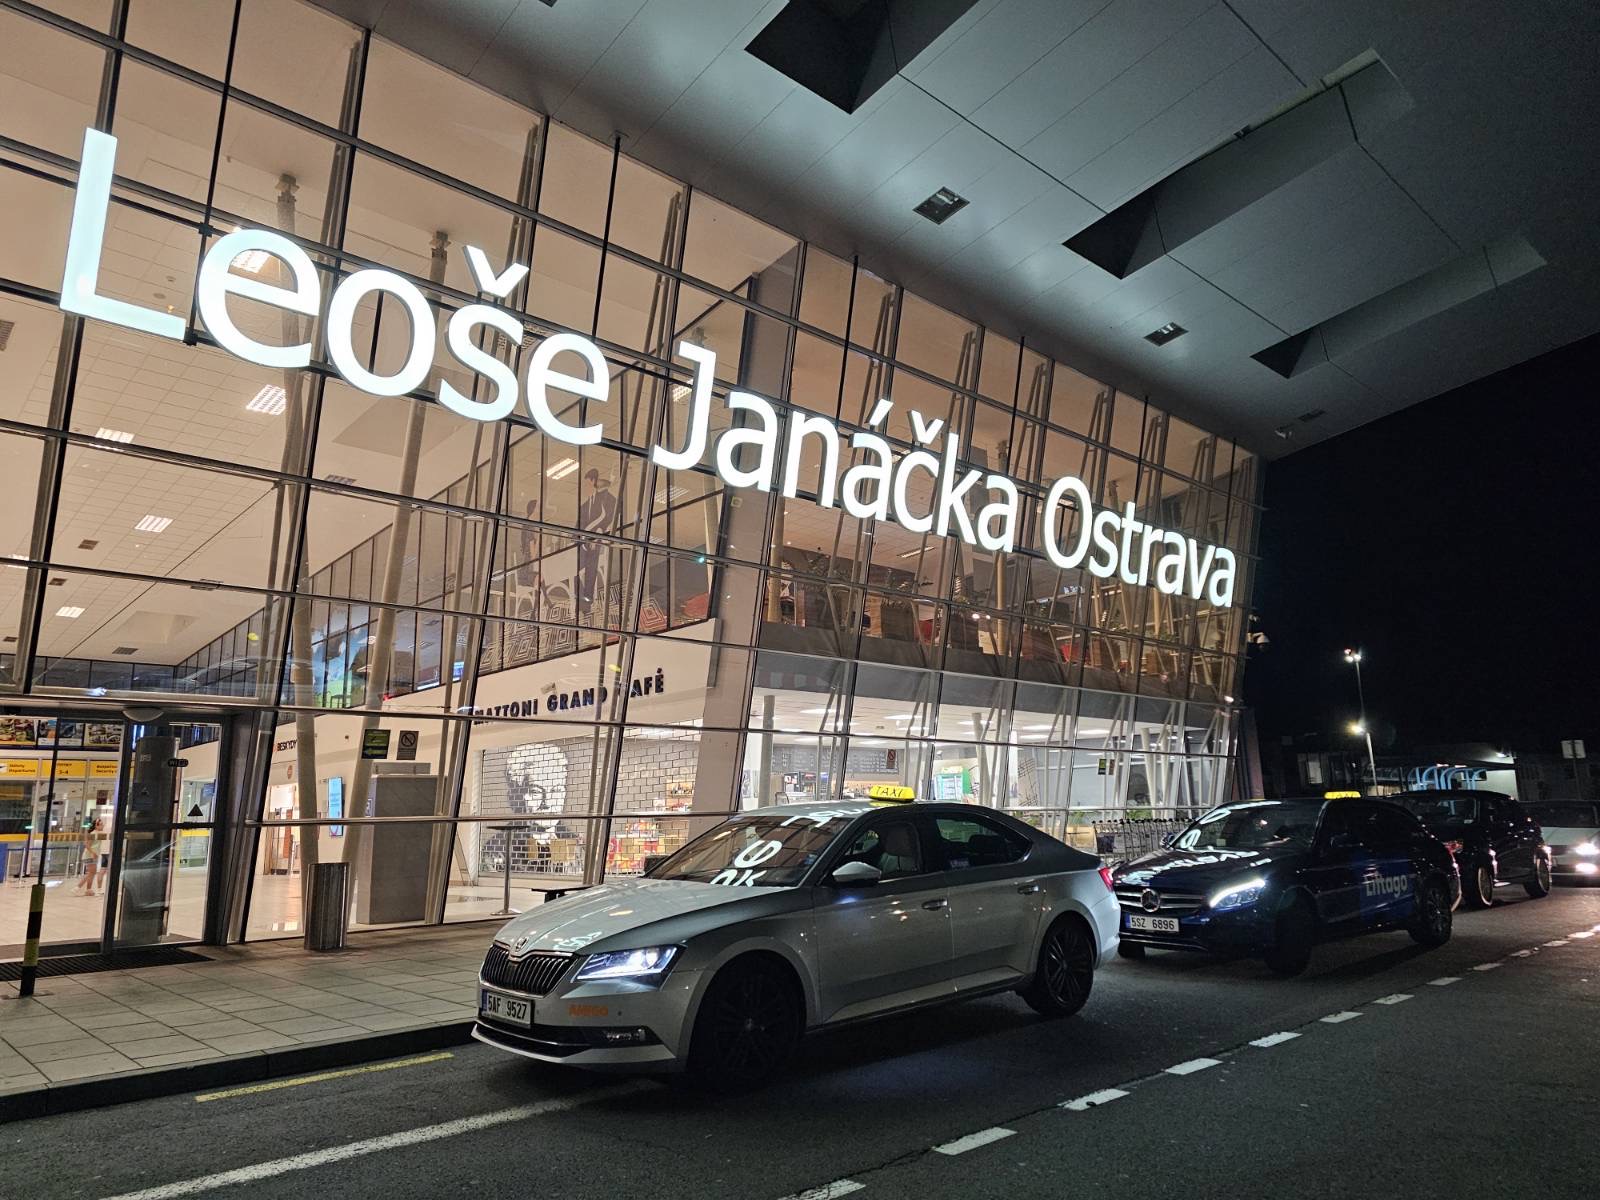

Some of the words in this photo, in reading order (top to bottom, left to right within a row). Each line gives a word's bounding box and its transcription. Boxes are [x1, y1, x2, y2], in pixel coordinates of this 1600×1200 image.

[60, 127, 611, 446] Leoše
[650, 341, 1019, 554] Janáčka
[1043, 475, 1237, 608] Ostrava
[876, 786, 904, 798] TAXI
[1131, 917, 1146, 928] 5SZ
[1152, 919, 1175, 930] 6896
[488, 995, 502, 1012] 5AF
[506, 1001, 527, 1020] 9527
